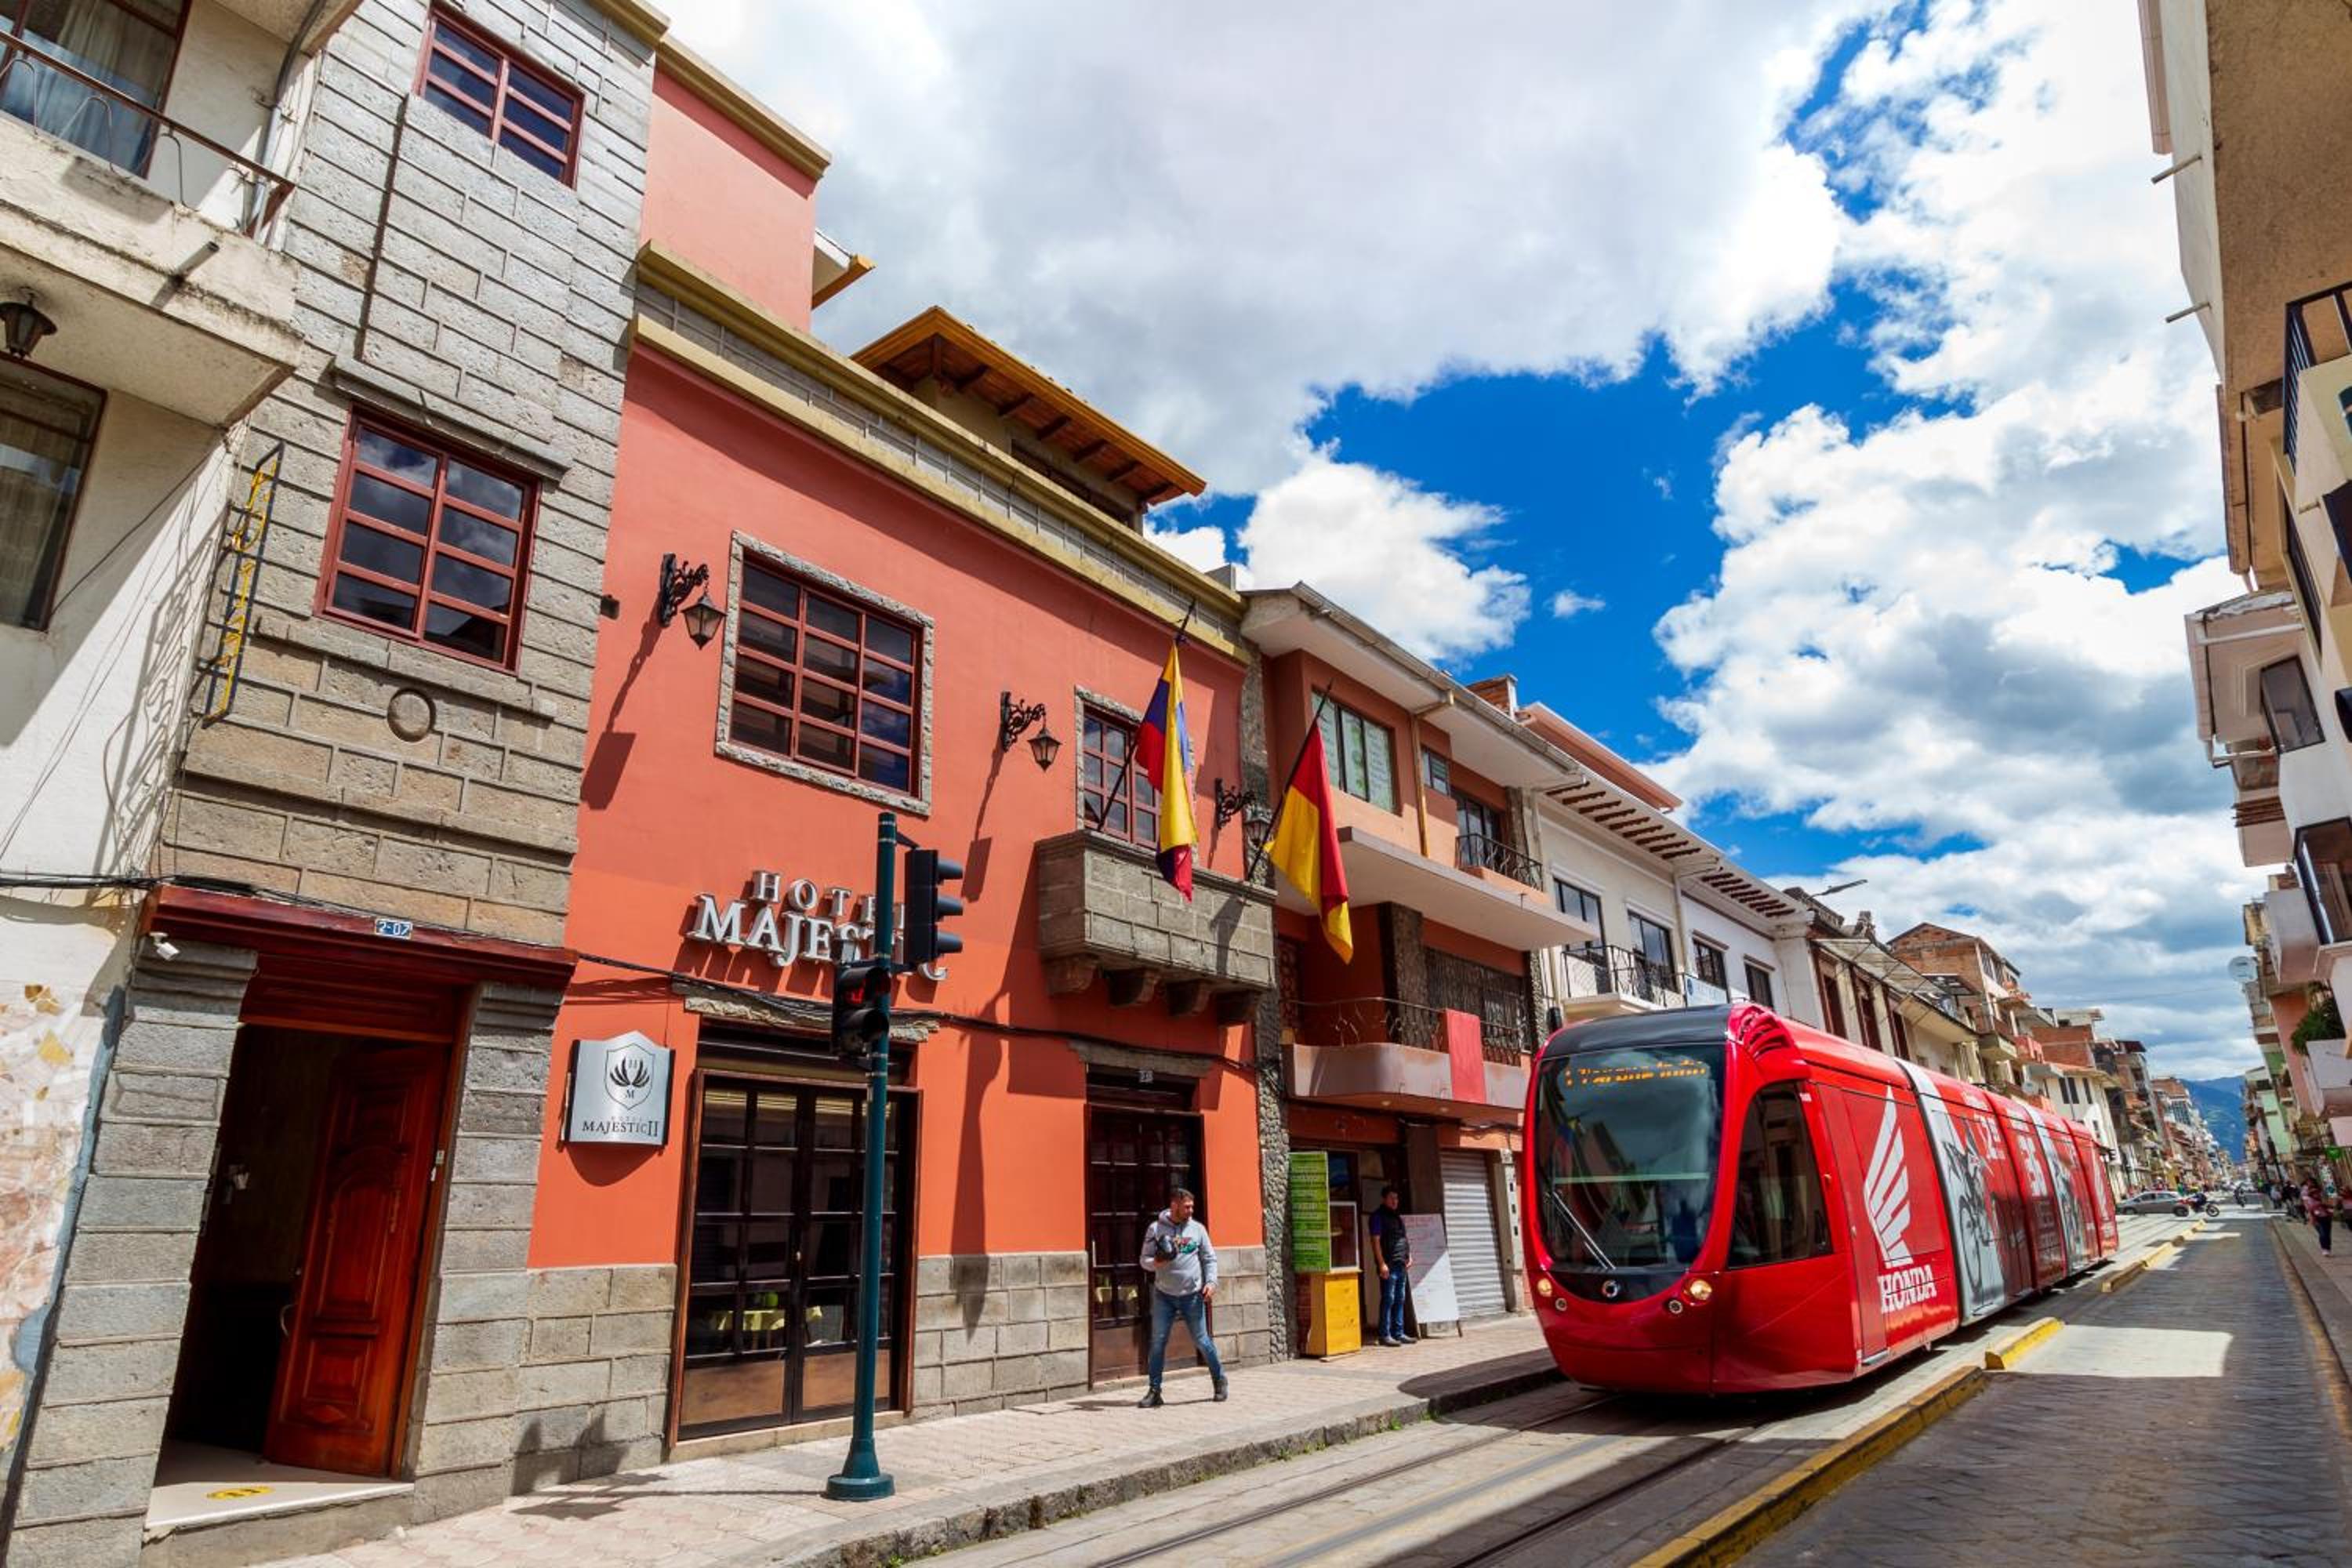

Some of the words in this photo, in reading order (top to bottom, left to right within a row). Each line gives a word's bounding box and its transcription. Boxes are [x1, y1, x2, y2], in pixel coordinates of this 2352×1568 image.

[379, 921, 410, 936] 2-07
[582, 1120, 648, 1135] MAJESTIC
[1877, 1264, 1937, 1314] HONDA
